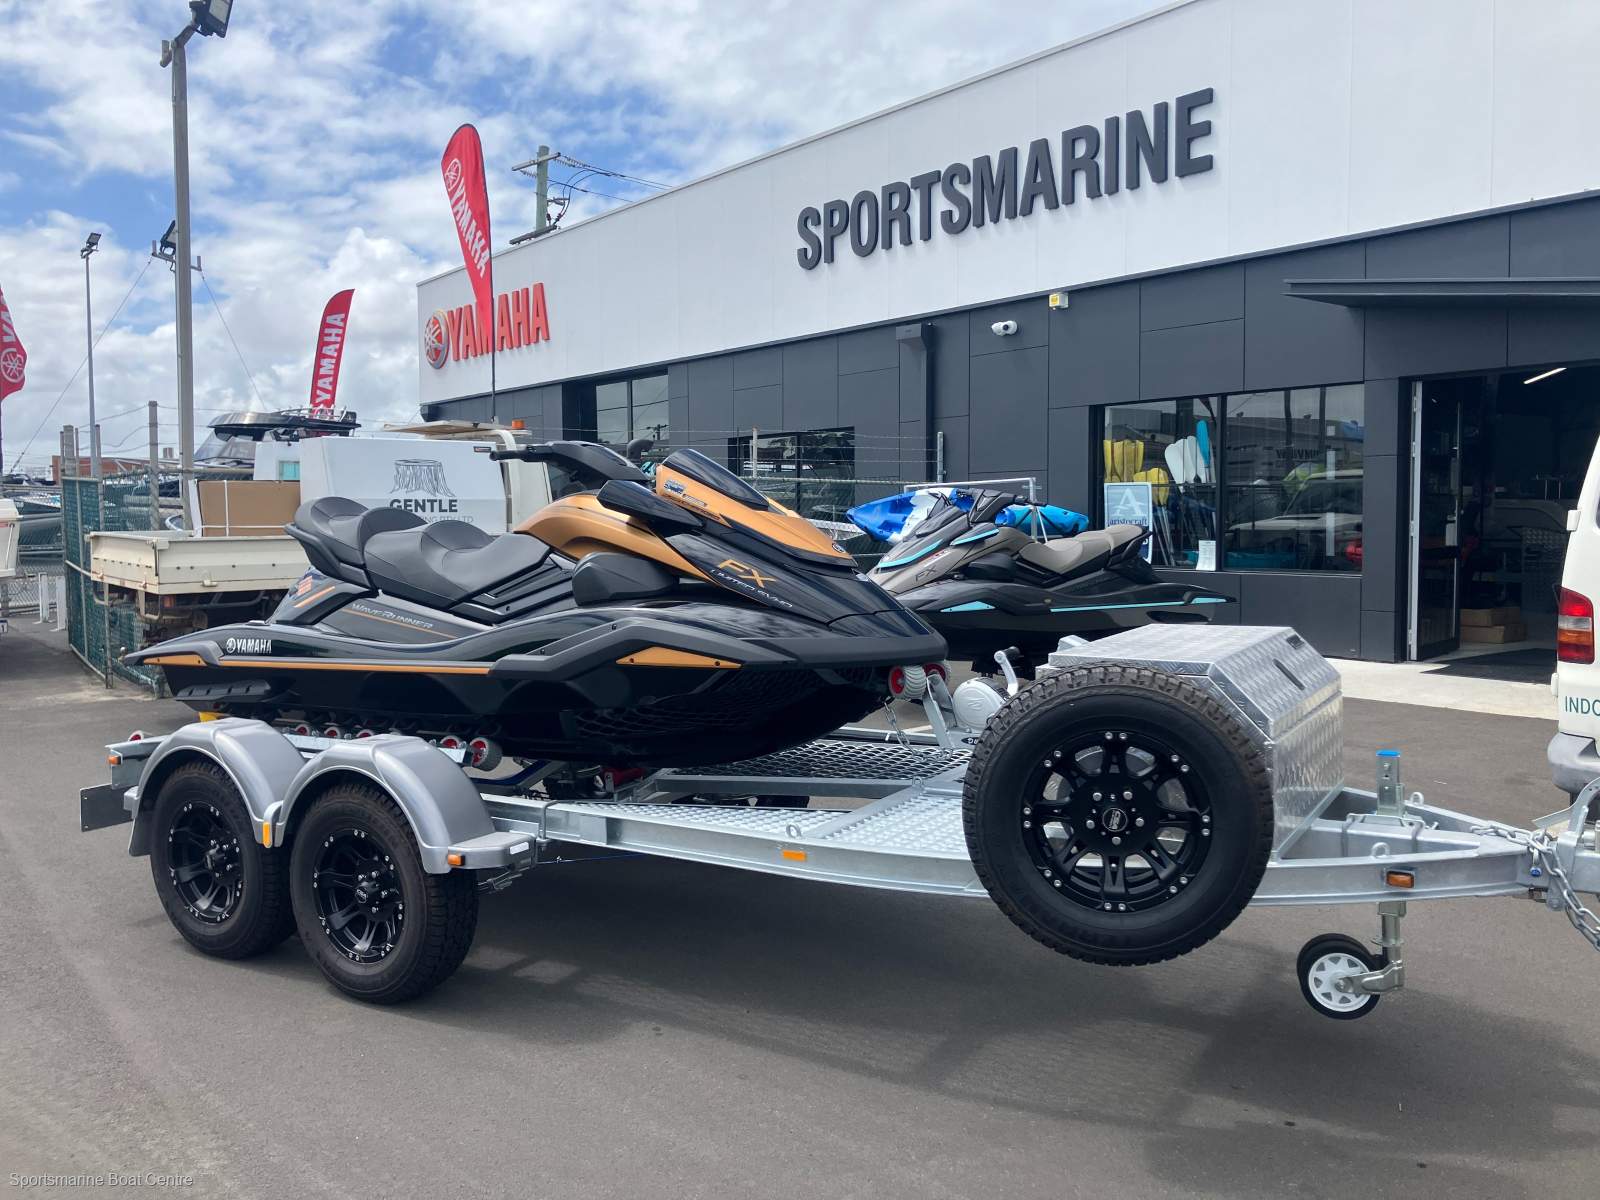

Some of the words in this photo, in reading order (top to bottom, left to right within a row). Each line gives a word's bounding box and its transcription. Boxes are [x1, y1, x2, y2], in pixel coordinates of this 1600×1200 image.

[797, 87, 1214, 270] SPORTSMARINE
[451, 177, 490, 278] YAMAHA
[316, 313, 346, 403] YAMAHA
[390, 499, 458, 513] GENTLE
[718, 559, 777, 588] FX
[236, 639, 272, 654] YAMAHA
